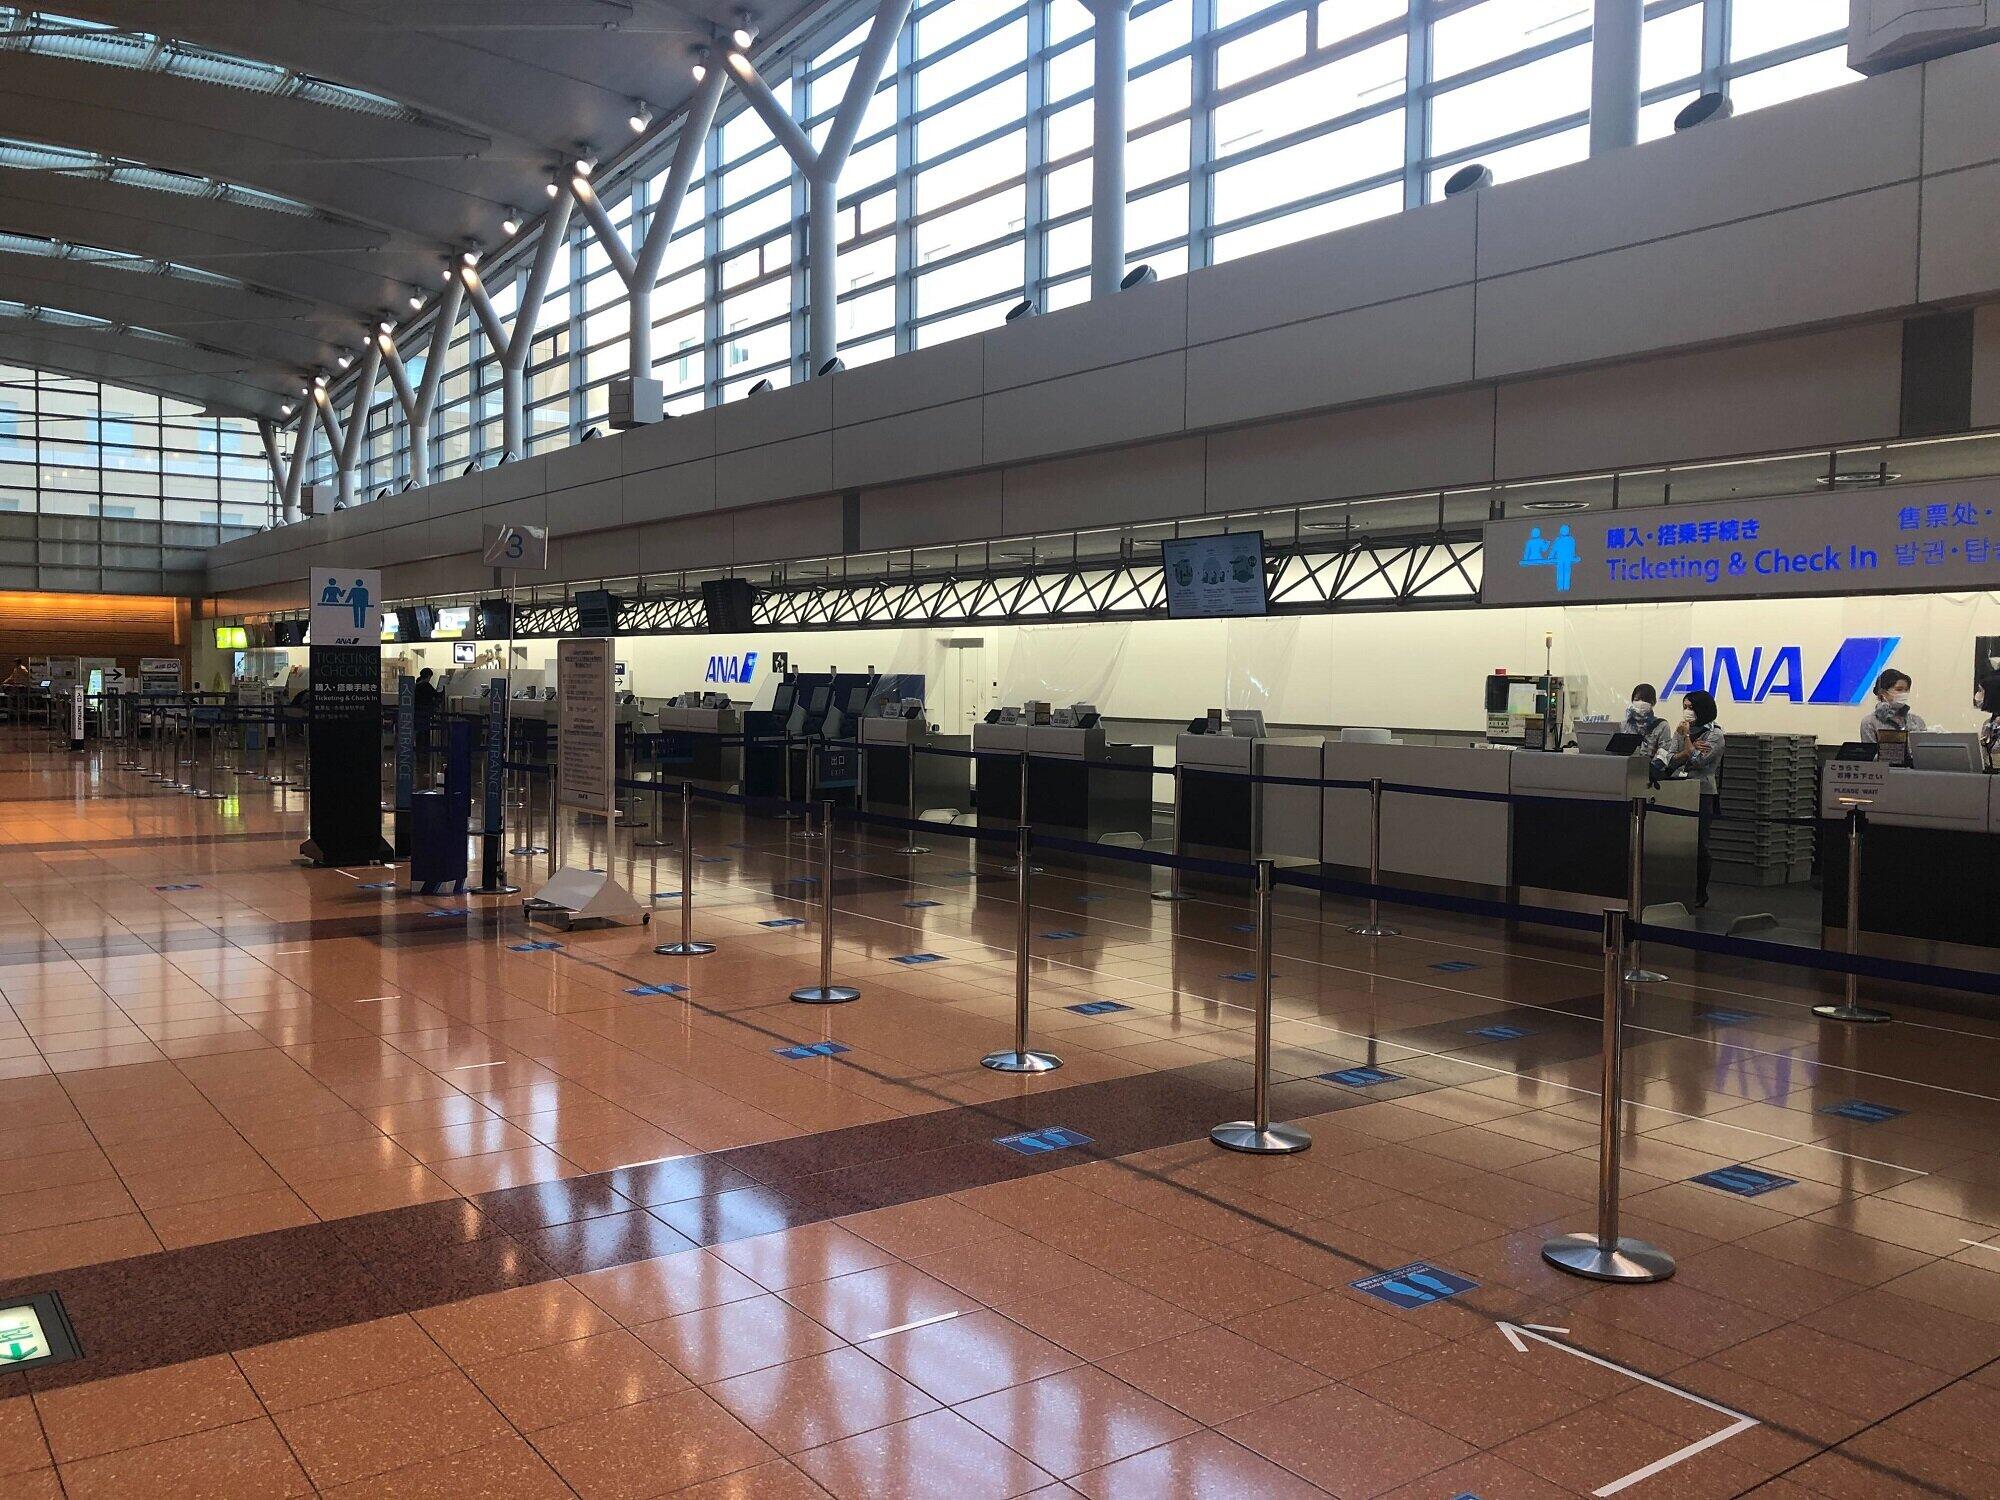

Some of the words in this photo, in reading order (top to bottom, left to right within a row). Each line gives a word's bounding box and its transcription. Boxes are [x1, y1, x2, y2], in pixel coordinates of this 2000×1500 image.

[506, 534, 523, 559] 3
[1607, 519, 1760, 549] 購入・搭乗手続き
[1606, 555, 1720, 583] Ticketing
[1728, 551, 1747, 576] &
[1754, 544, 1841, 574] Check
[1850, 544, 1878, 570] In
[335, 637, 351, 645] ANA
[314, 652, 377, 665] TICKETING
[705, 655, 739, 684] ANA
[1658, 646, 1804, 704] ANA
[315, 694, 344, 702] Ticketing
[401, 683, 413, 706] 入口
[492, 688, 501, 714] 入口
[399, 712, 414, 781] ENTRANCE
[488, 721, 503, 800] ENTRANCE
[831, 755, 845, 766] 出口
[831, 768, 845, 776] EXIT
